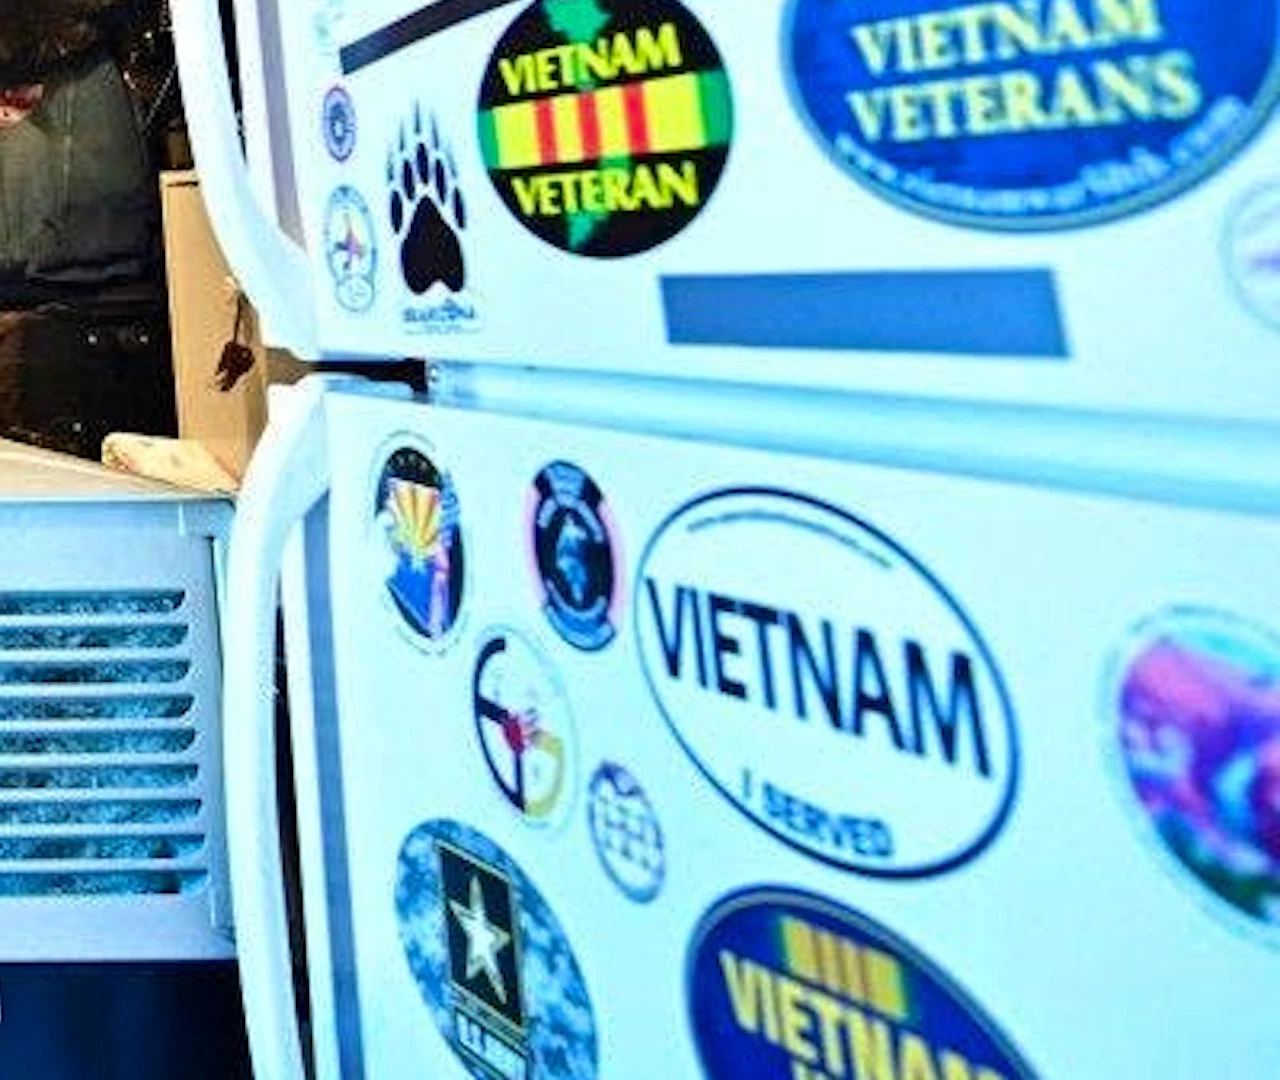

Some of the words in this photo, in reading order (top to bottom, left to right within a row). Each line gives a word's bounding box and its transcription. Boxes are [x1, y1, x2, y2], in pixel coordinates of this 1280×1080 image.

[499, 22, 682, 96] VIETNAM
[845, 49, 1202, 144] VETERANS
[511, 160, 700, 217] VETERAN
[645, 576, 991, 779] VIETNAM
[742, 768, 752, 799] I
[762, 781, 894, 858] SERVED
